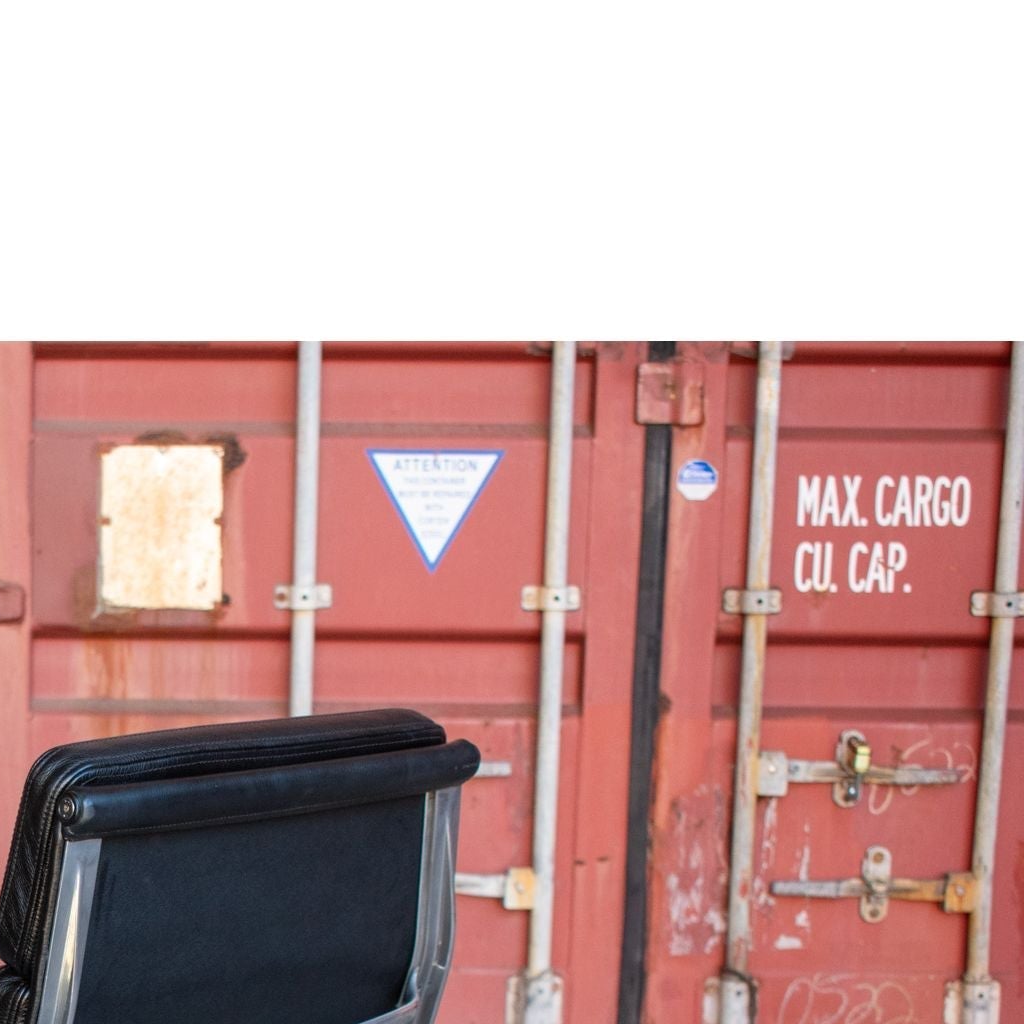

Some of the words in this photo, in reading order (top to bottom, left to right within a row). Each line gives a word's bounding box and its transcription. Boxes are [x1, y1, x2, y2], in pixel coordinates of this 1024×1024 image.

[796, 474, 869, 528] MAX.
[874, 474, 972, 528] CARGO
[793, 541, 838, 593] CU.
[847, 541, 912, 594] CAP.
